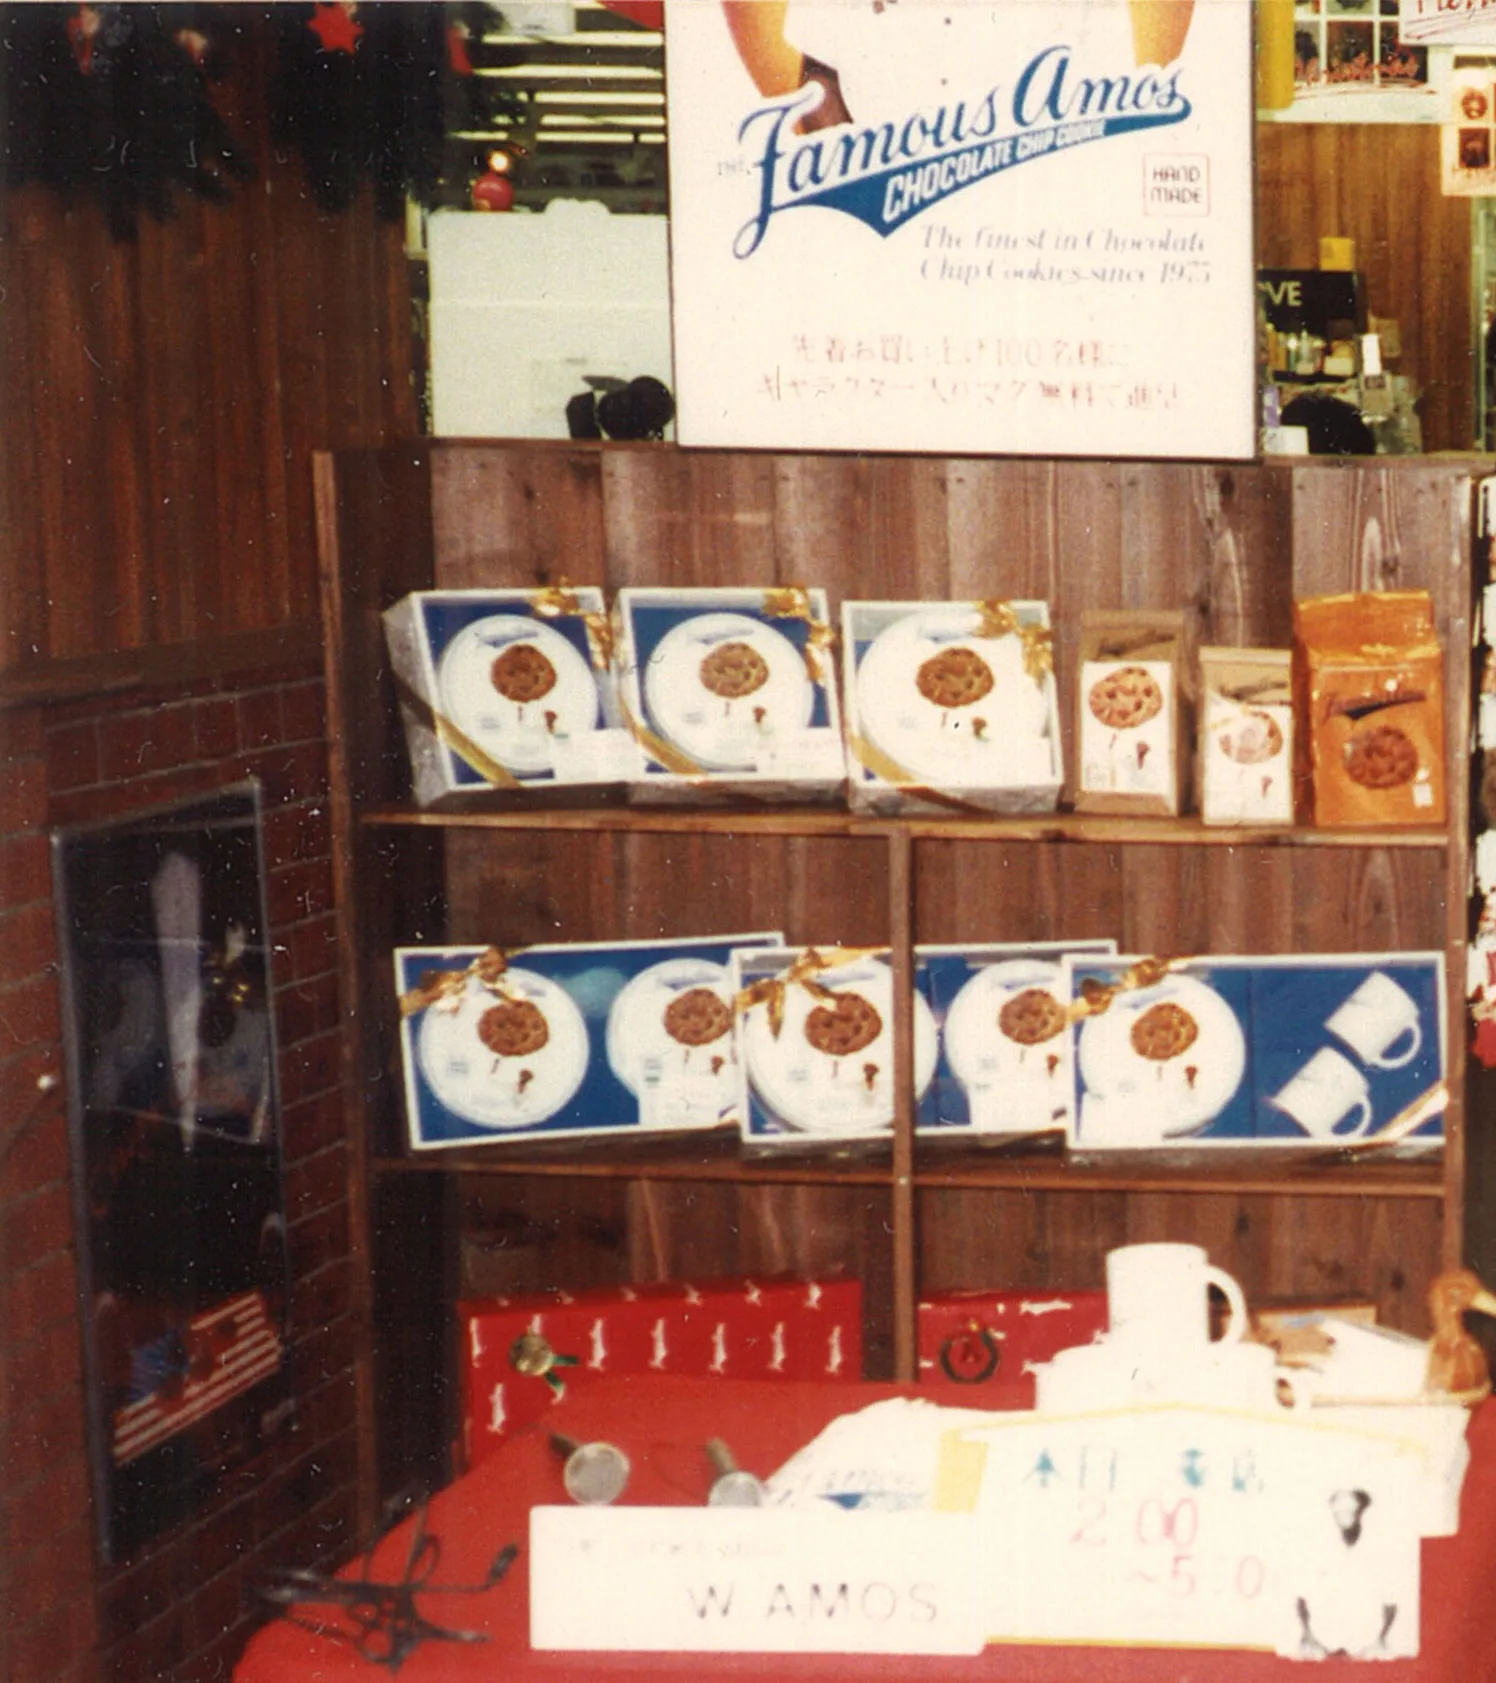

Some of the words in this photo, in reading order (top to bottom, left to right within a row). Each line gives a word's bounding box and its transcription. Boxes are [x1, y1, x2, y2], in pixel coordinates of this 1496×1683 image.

[732, 86, 999, 260] Famous
[1012, 44, 1186, 127] Amos
[882, 137, 1013, 225] CHOCOLATE
[1017, 128, 1055, 159] CHIP
[1152, 165, 1202, 183] HAND
[1150, 186, 1203, 205] MADE
[921, 223, 962, 250] The
[1055, 229, 1079, 251] in
[1085, 225, 1205, 254] Chocolate
[920, 254, 981, 286] Chip
[765, 1581, 938, 1623] AMOS
